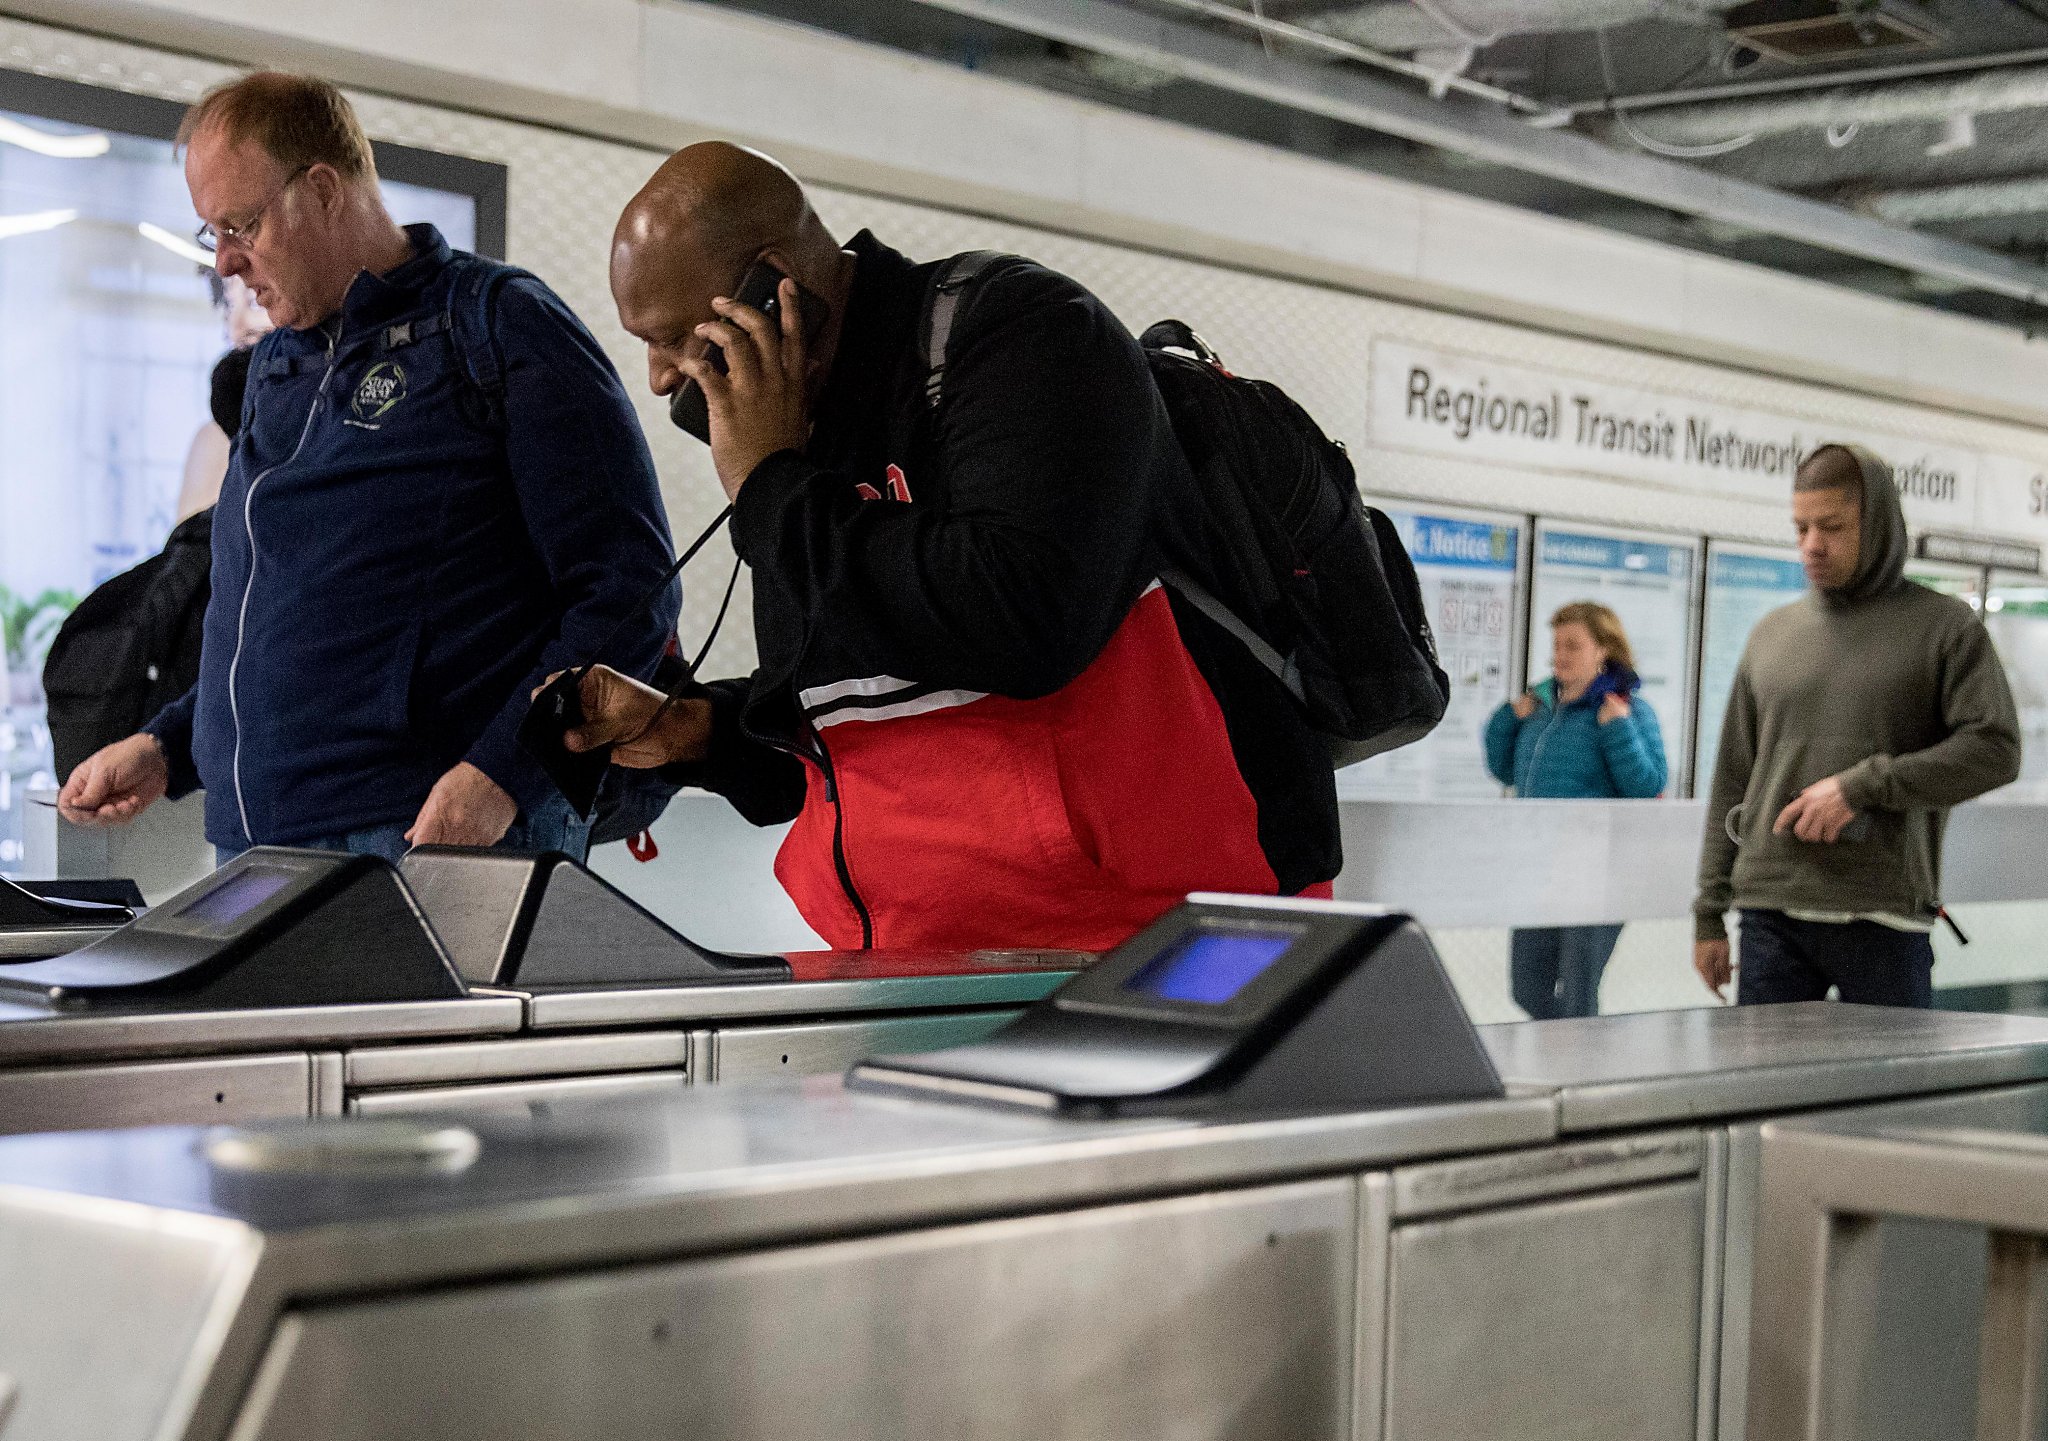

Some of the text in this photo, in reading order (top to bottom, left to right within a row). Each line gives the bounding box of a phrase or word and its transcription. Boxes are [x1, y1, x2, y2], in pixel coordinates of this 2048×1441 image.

[1407, 369, 1558, 439] Regional
[1571, 398, 1675, 460] Transit
[1684, 416, 1803, 475] Network
[1430, 526, 1489, 559] Notice
